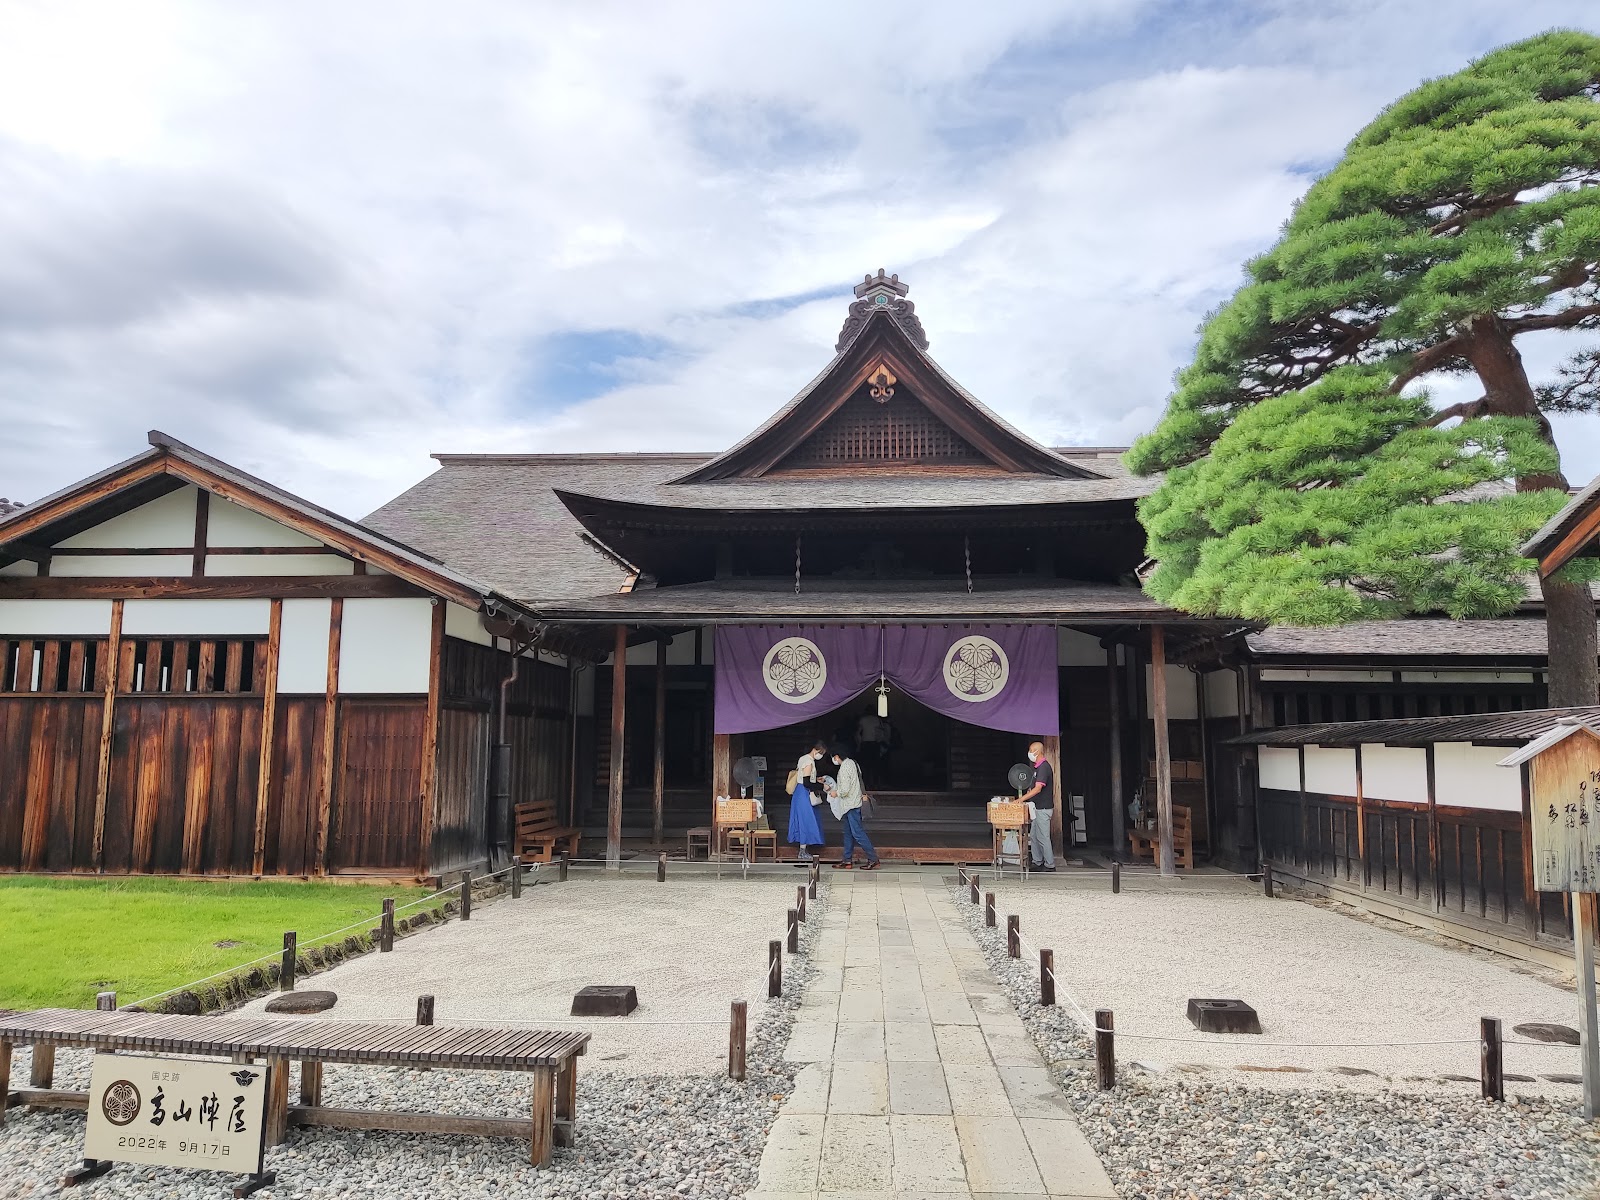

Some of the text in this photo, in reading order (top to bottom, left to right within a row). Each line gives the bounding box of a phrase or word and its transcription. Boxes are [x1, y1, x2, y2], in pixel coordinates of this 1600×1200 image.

[151, 1071, 181, 1083] 国史跡
[118, 1136, 231, 1156] 2022年 9月17日
